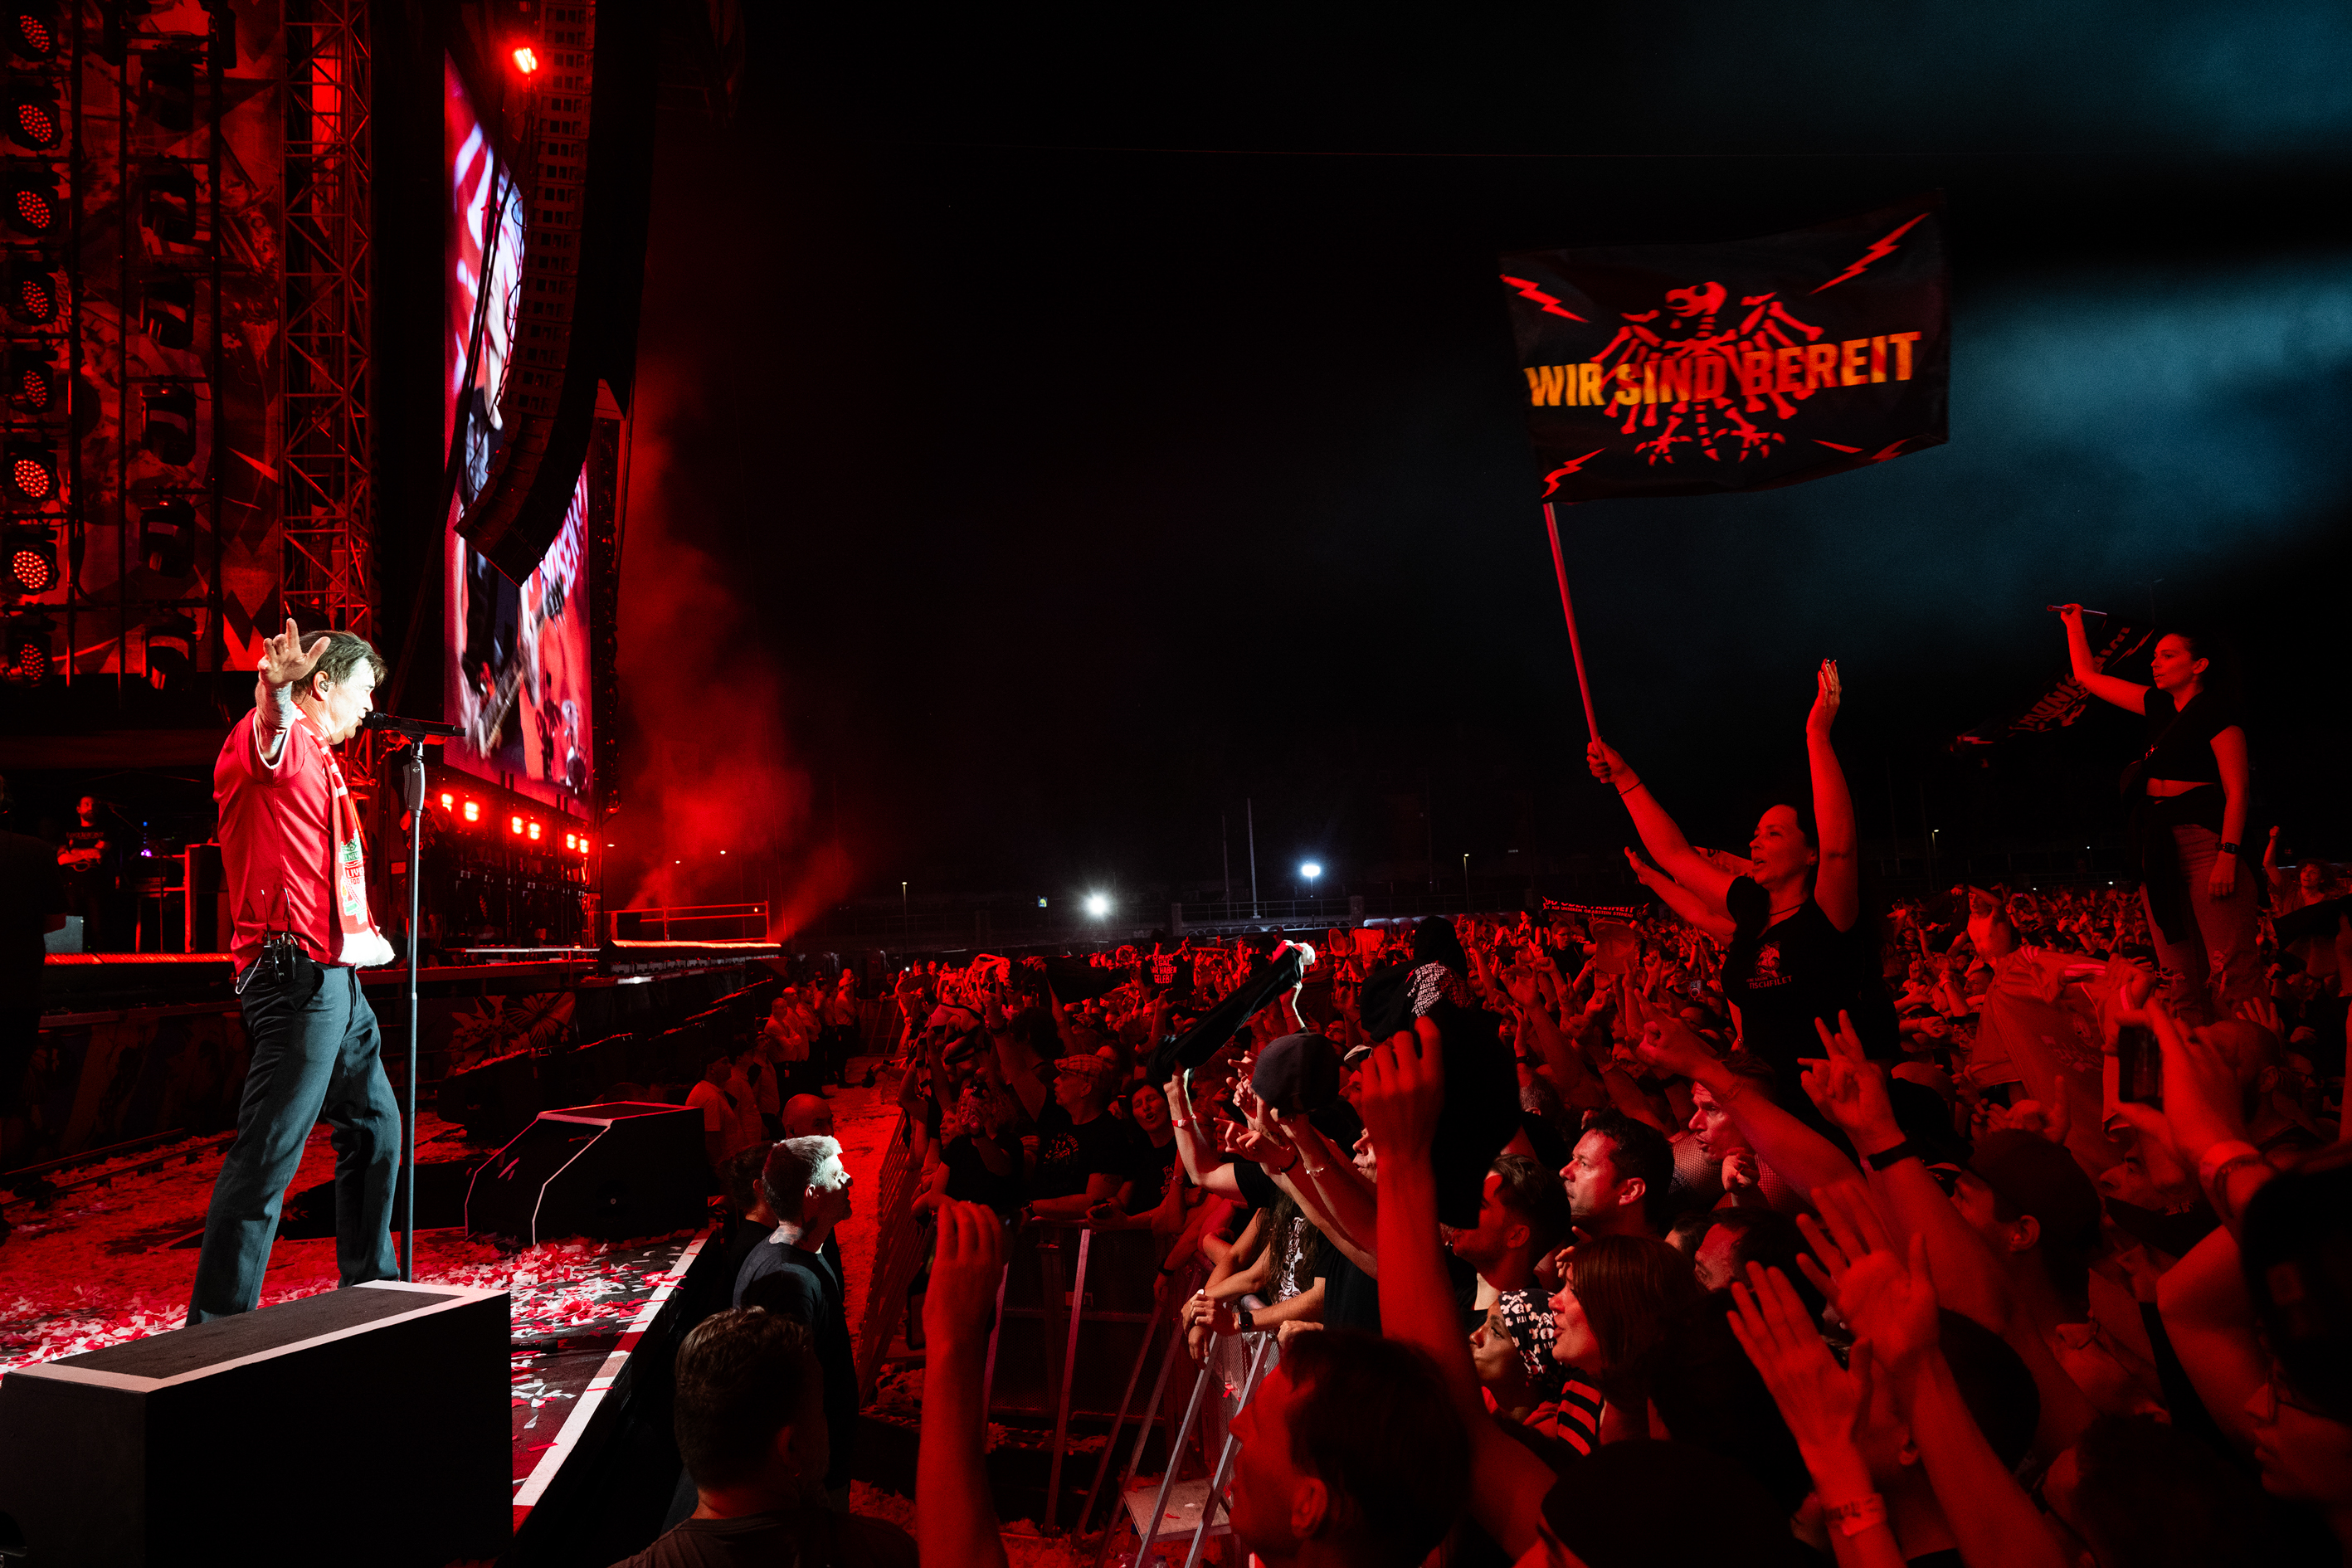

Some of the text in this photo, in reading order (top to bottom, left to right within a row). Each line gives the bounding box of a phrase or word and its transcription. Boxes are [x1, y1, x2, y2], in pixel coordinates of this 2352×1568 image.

[1523, 330, 1922, 407] WIR SIND BEREIT
[1749, 975, 1792, 989] FISCHFILET
